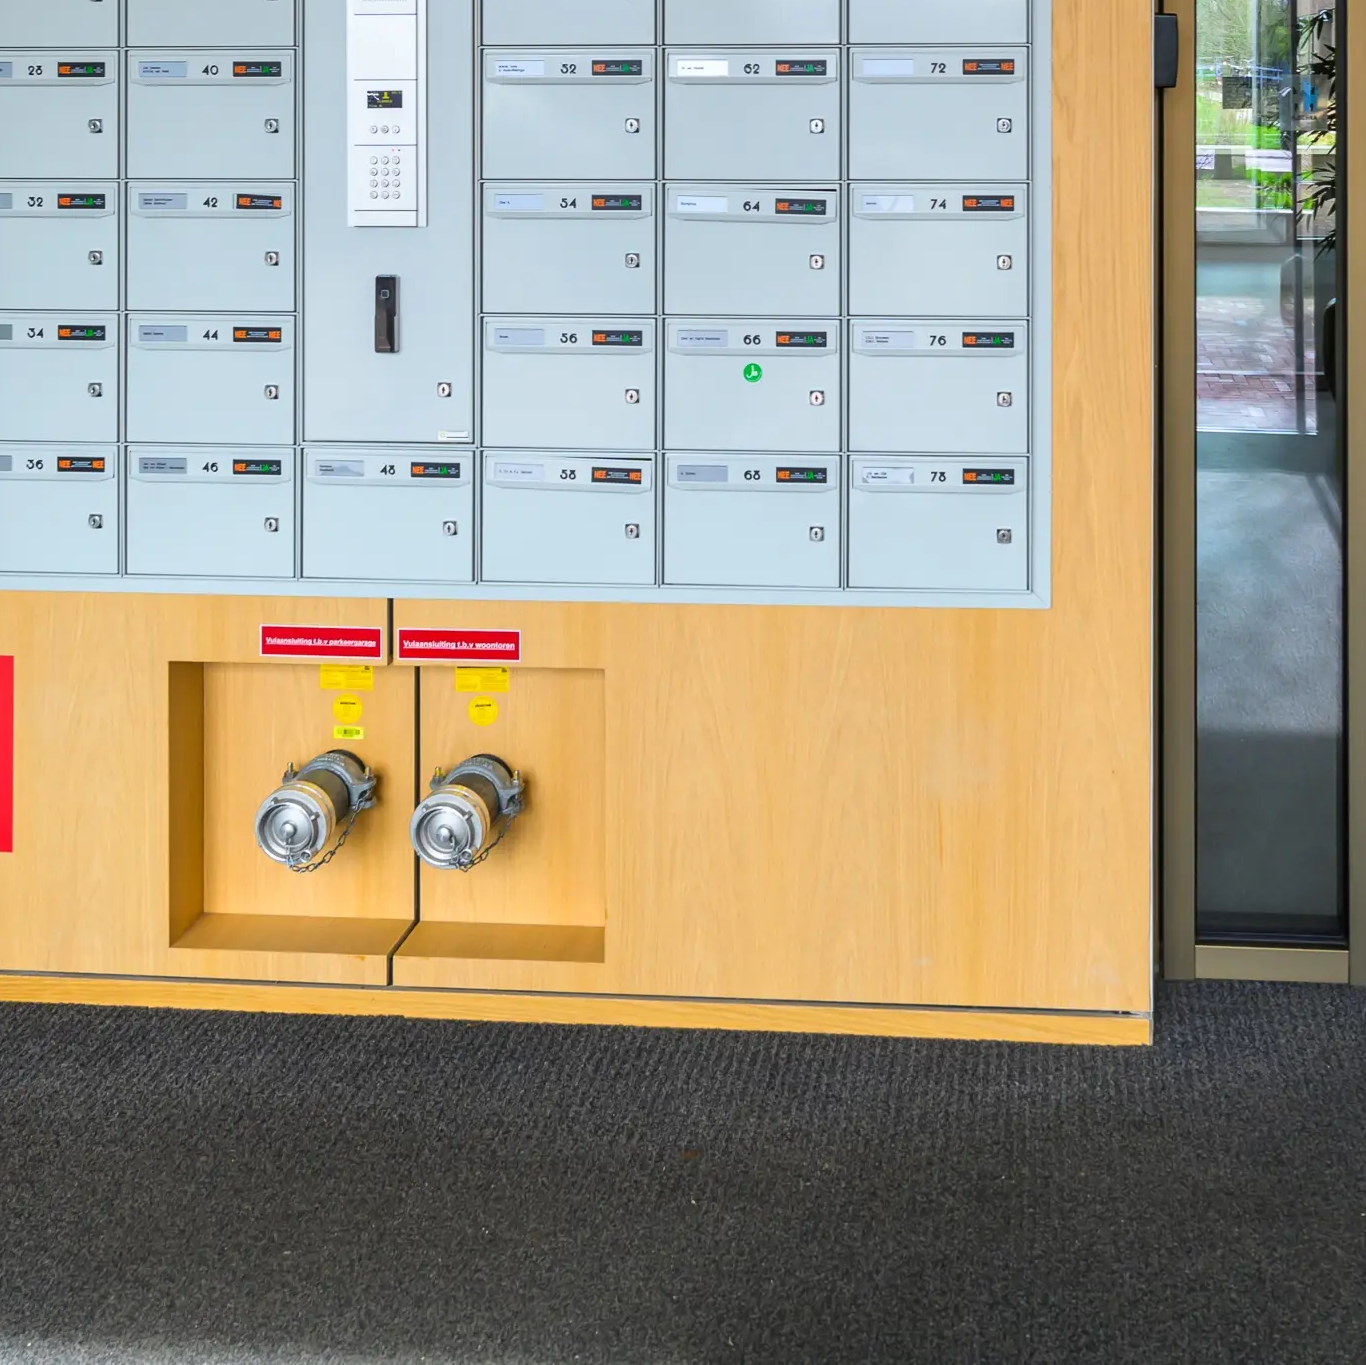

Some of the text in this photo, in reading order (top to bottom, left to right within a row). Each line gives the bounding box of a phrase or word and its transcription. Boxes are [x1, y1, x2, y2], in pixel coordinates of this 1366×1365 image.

[27, 65, 43, 76] 28
[201, 64, 219, 76] 40
[560, 63, 577, 75] 52
[743, 63, 761, 75] 62
[930, 62, 947, 74] 72
[27, 196, 44, 208] 32
[202, 196, 218, 208] 42
[559, 197, 577, 209] 54
[742, 200, 760, 212] 64
[930, 198, 947, 210] 74
[26, 327, 44, 339] 34
[202, 329, 219, 341] 44
[559, 332, 578, 344] 56
[743, 334, 762, 346] 66
[929, 335, 947, 346] 76
[25, 459, 44, 470] 36
[202, 461, 219, 473] 46
[379, 464, 396, 476] 48
[559, 469, 577, 481] 58
[743, 469, 761, 481] 68
[930, 471, 947, 483] 78
[475, 642, 515, 650] woontoren
